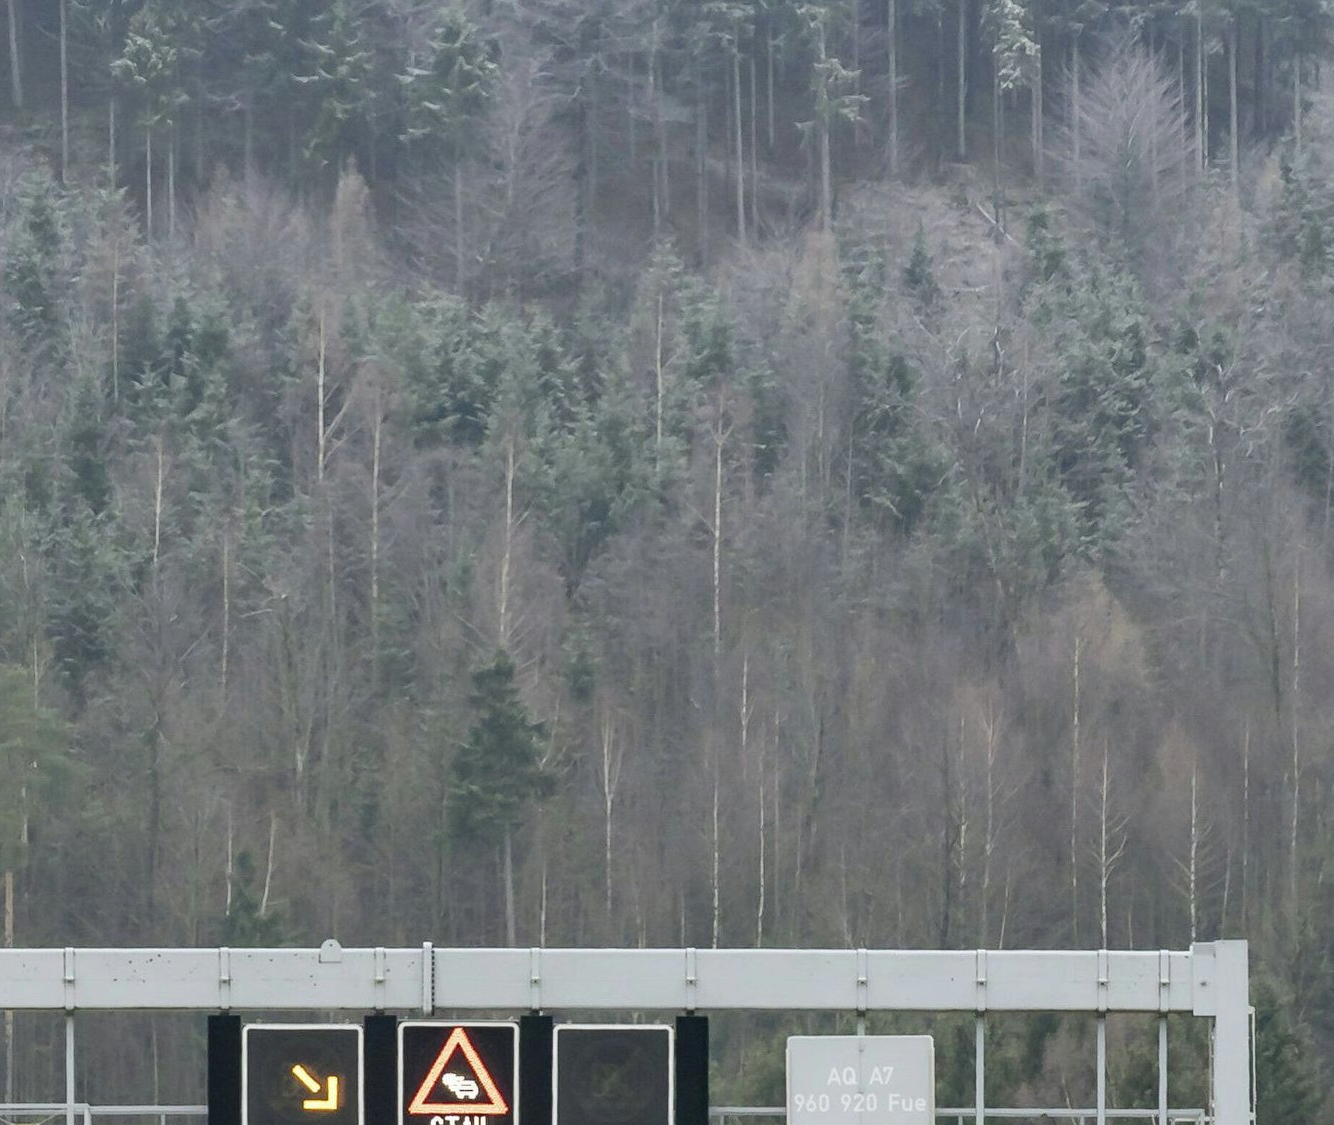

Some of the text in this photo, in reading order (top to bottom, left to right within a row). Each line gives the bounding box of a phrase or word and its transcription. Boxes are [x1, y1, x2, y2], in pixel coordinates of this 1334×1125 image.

[827, 1065, 894, 1086] AQ A7
[794, 1093, 927, 1113] 960 920 Fue
